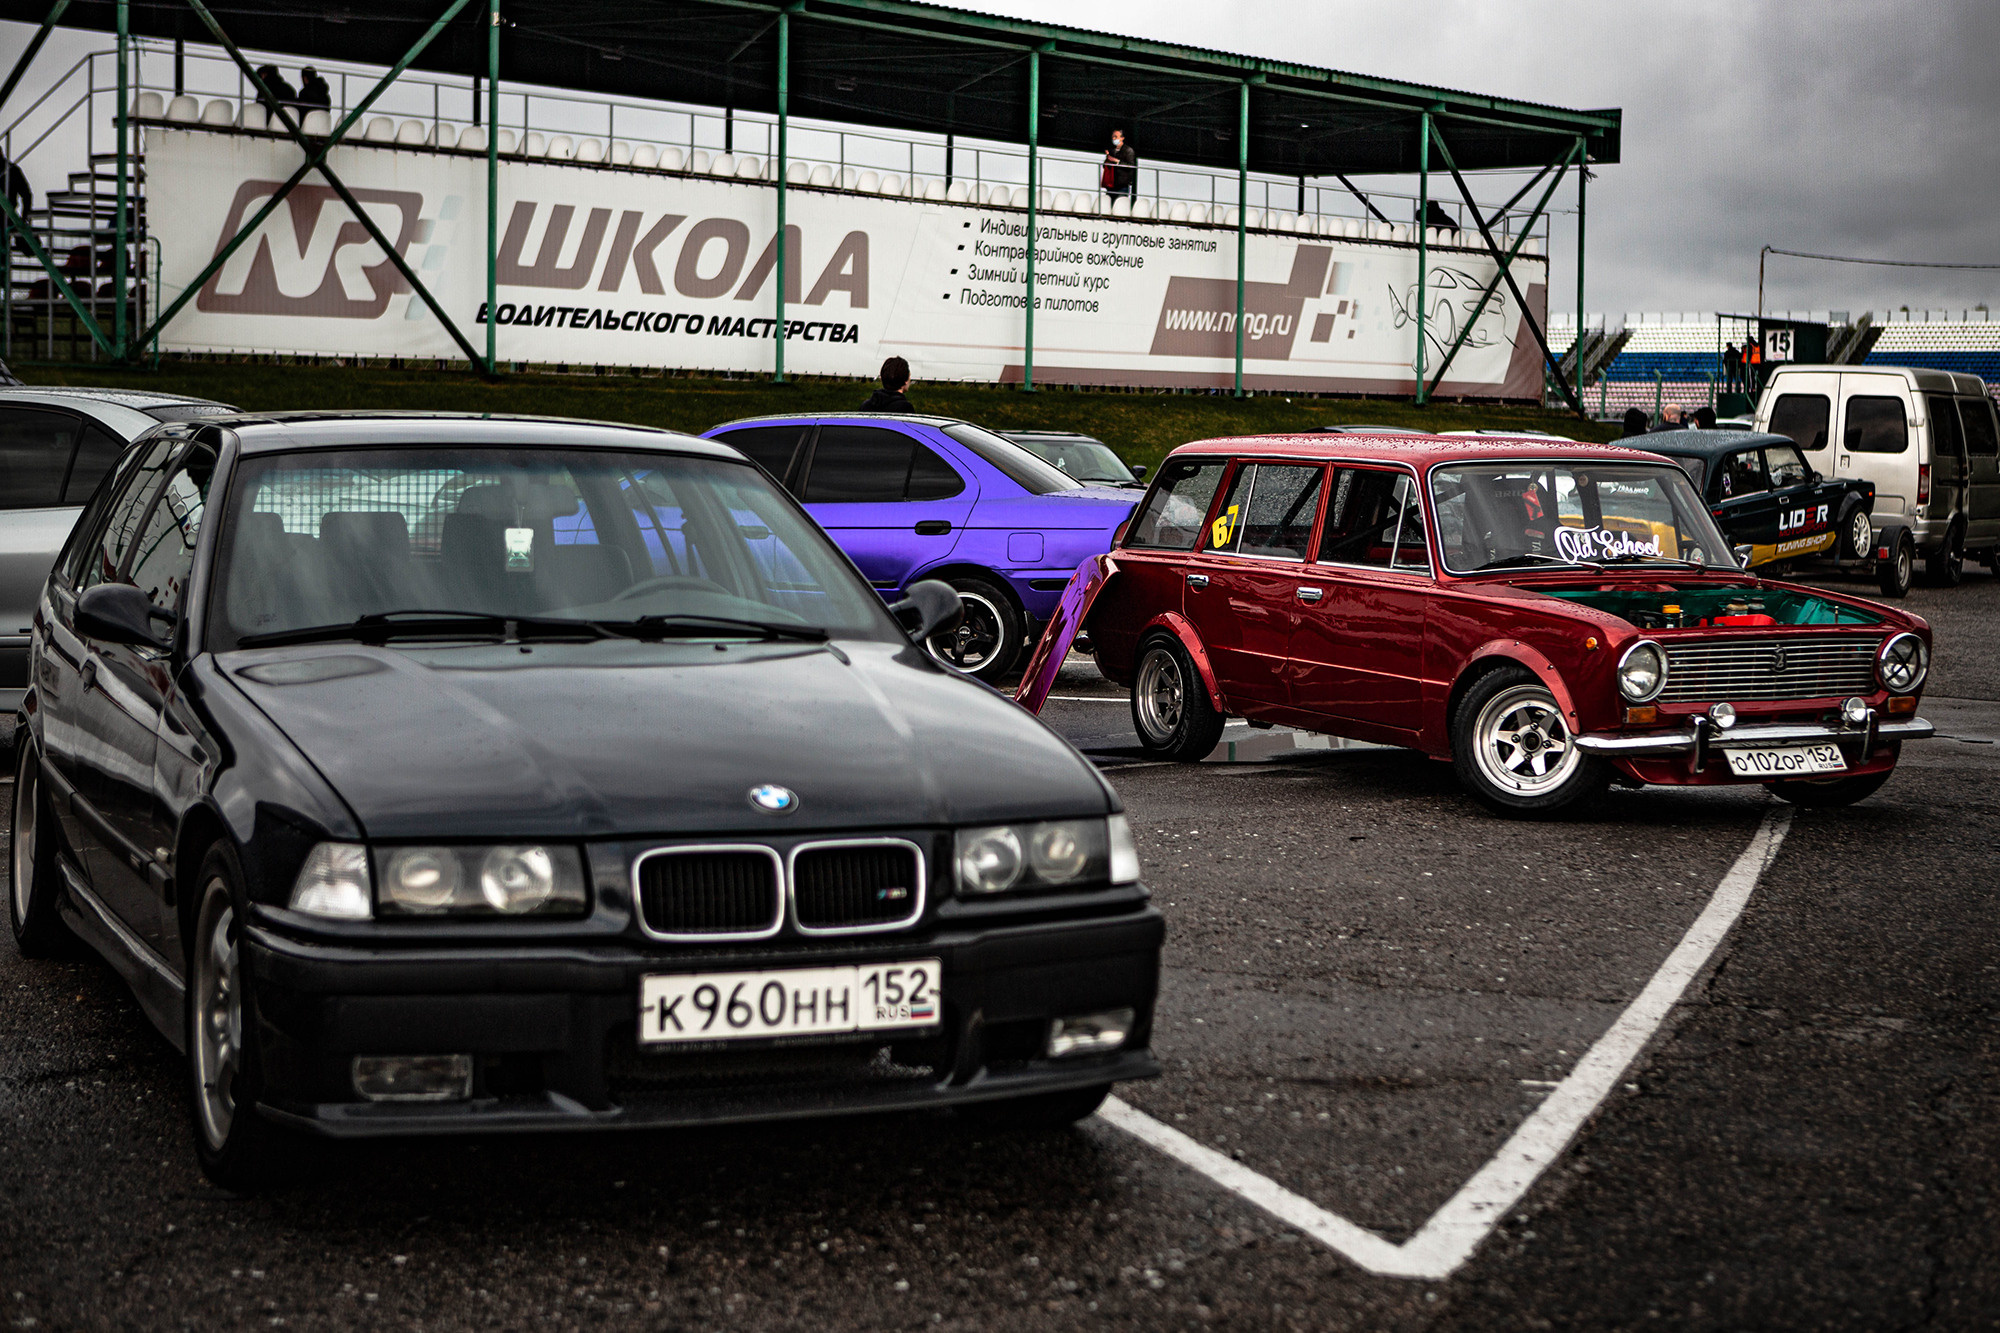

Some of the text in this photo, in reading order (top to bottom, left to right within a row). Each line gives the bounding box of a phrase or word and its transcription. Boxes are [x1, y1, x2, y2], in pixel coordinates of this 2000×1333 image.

[980, 217, 1218, 253] Индивиуальные и групповые занятия
[496, 201, 870, 309] ШКОЛА
[1087, 250, 1144, 269] вождение
[968, 263, 1018, 283] Зимний
[1083, 277, 1110, 293] курс
[960, 288, 1100, 313] Подготова пилотов
[476, 302, 859, 344] ВОДИТЕЛЬСКОГО МАСТЕРСТВА
[1165, 307, 1293, 340] www.nrng.ru
[1769, 332, 1790, 352] 15
[1212, 504, 1239, 548] 67
[1779, 504, 1828, 531] LIDER
[1554, 525, 1600, 565] Old
[1592, 529, 1664, 560] School
[1778, 534, 1827, 552] TUNING SHOP
[1807, 746, 1838, 763] 152
[864, 967, 929, 1006] 152
[876, 1005, 910, 1020] RUS
